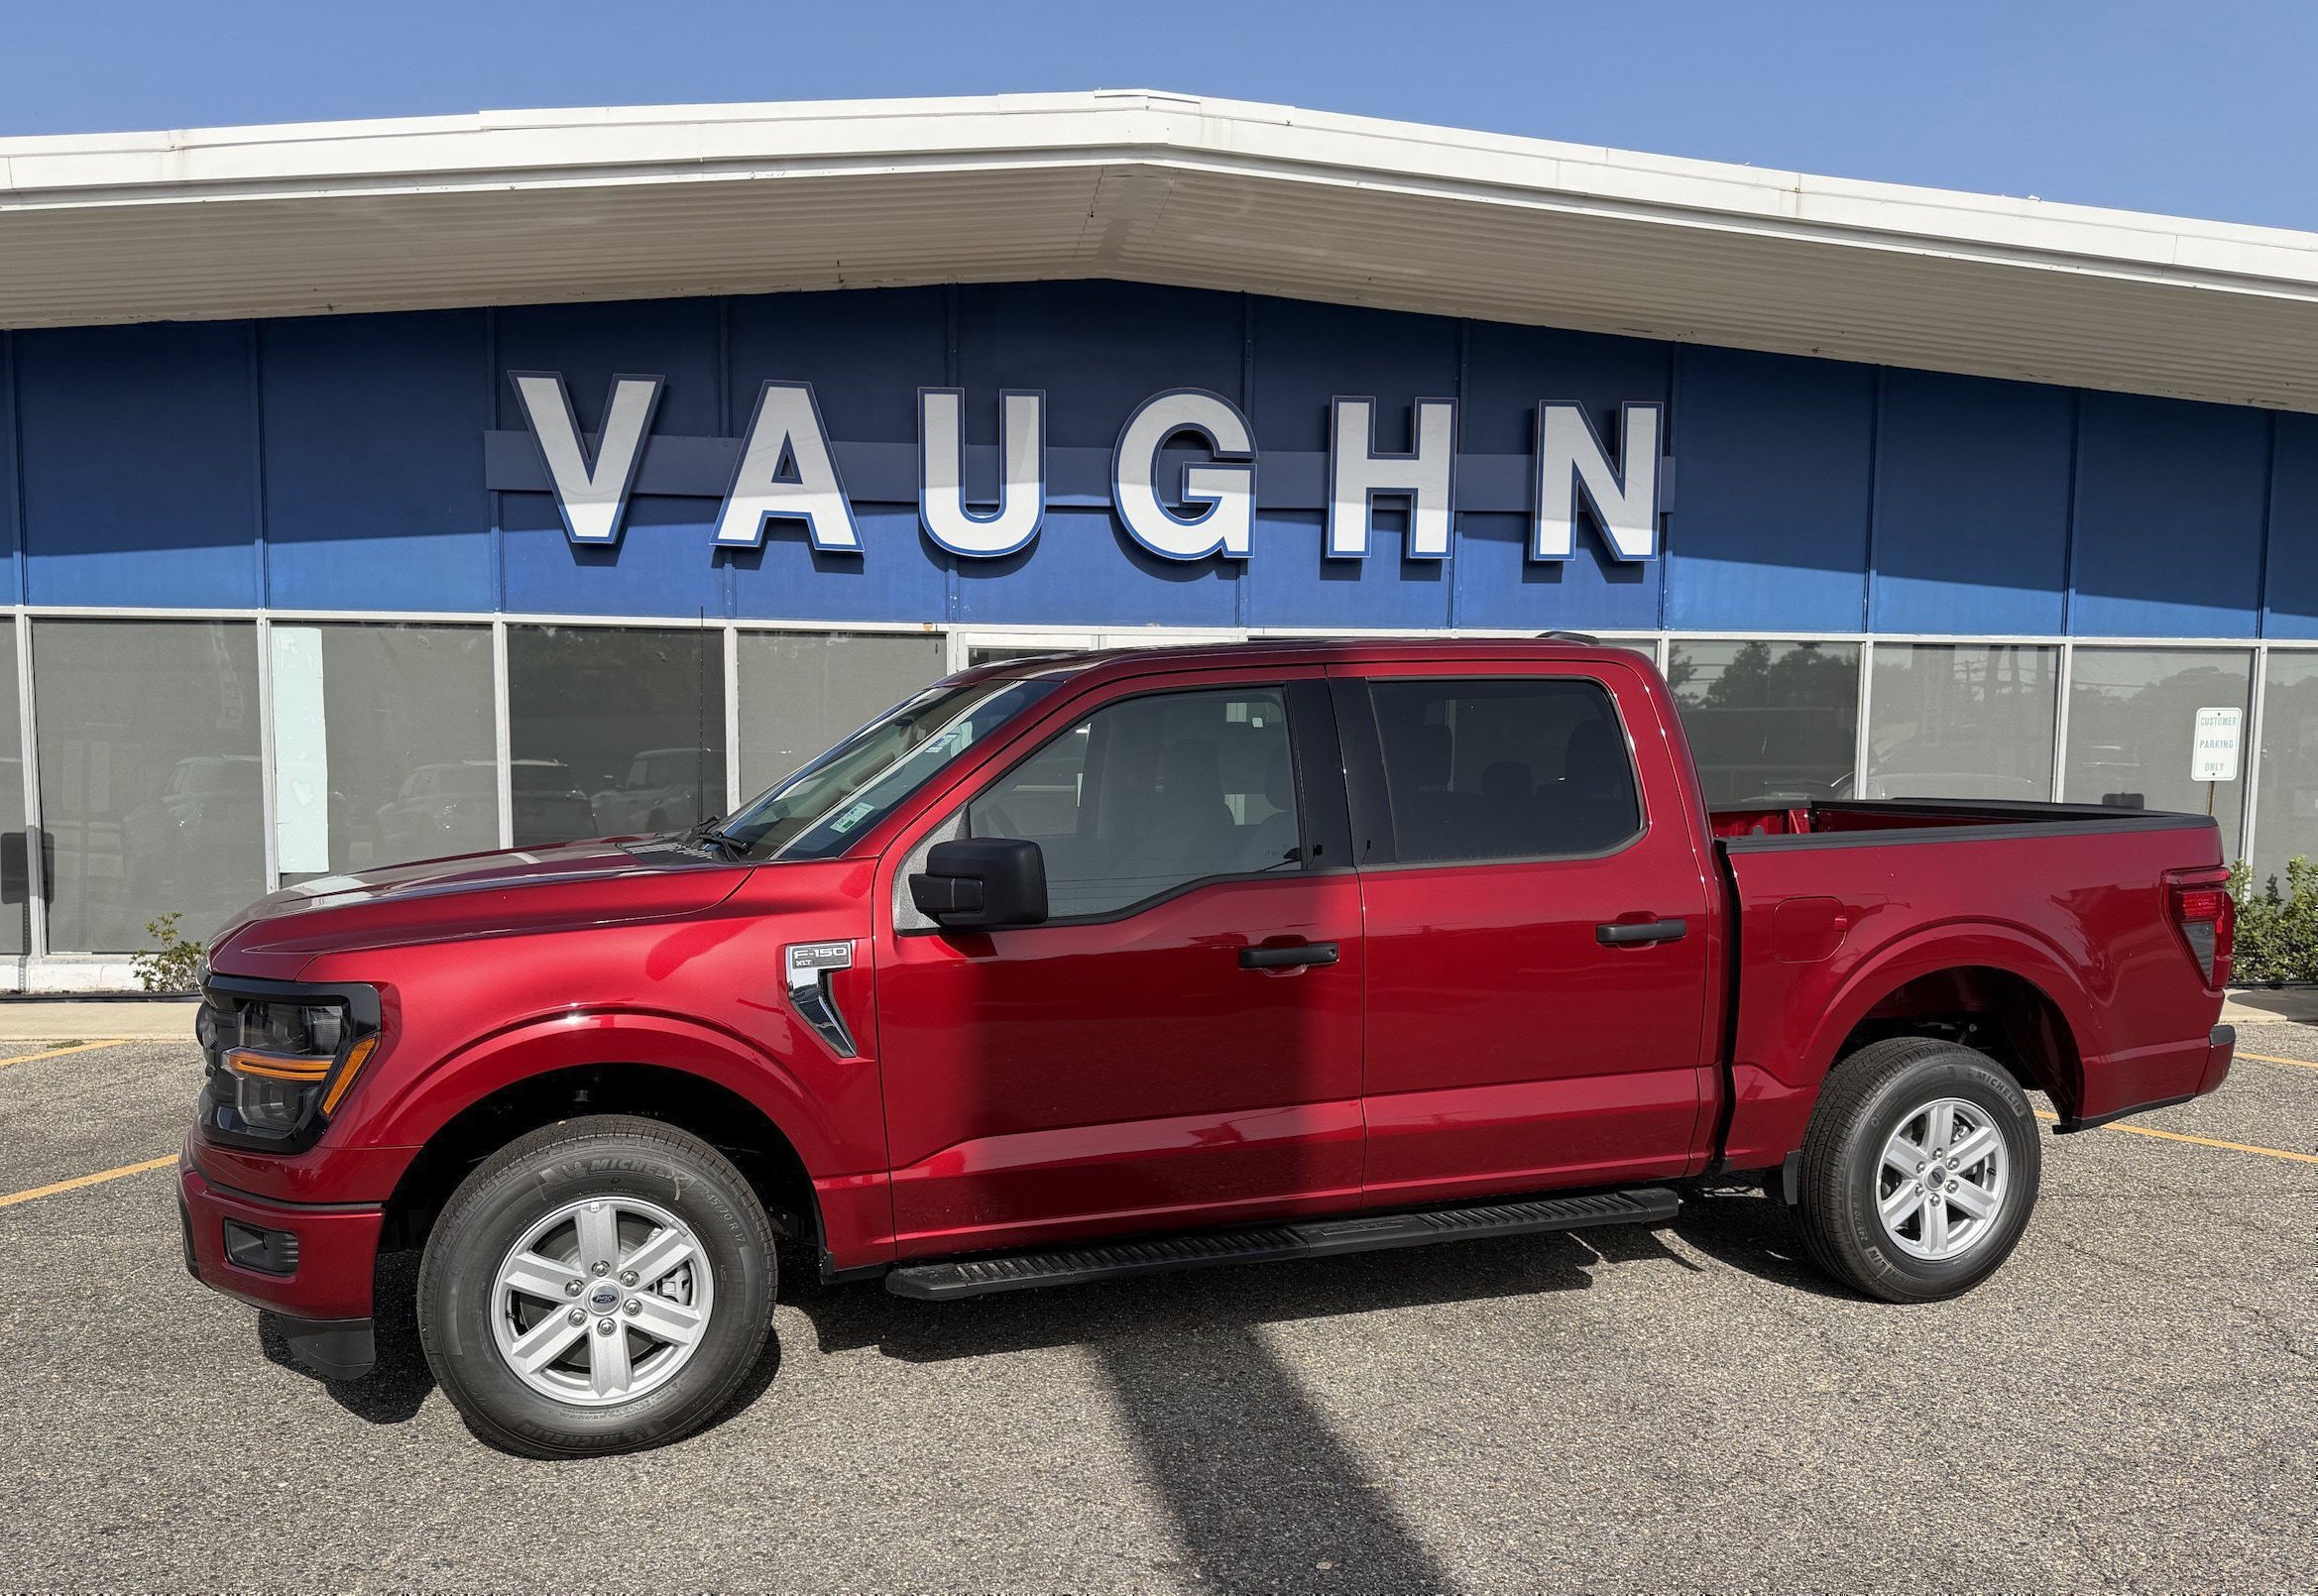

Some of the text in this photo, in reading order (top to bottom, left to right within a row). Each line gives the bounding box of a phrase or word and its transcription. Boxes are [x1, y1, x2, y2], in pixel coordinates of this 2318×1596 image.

[507, 370, 1664, 562] VAUGHN
[2200, 717, 2237, 727] CUSTOMER
[2199, 740, 2234, 749] PARKING
[2205, 762, 2225, 771] ONLY
[793, 947, 848, 960] F-150
[1975, 1071, 2024, 1113] MICHELIN
[590, 1158, 689, 1183] MICHEL
